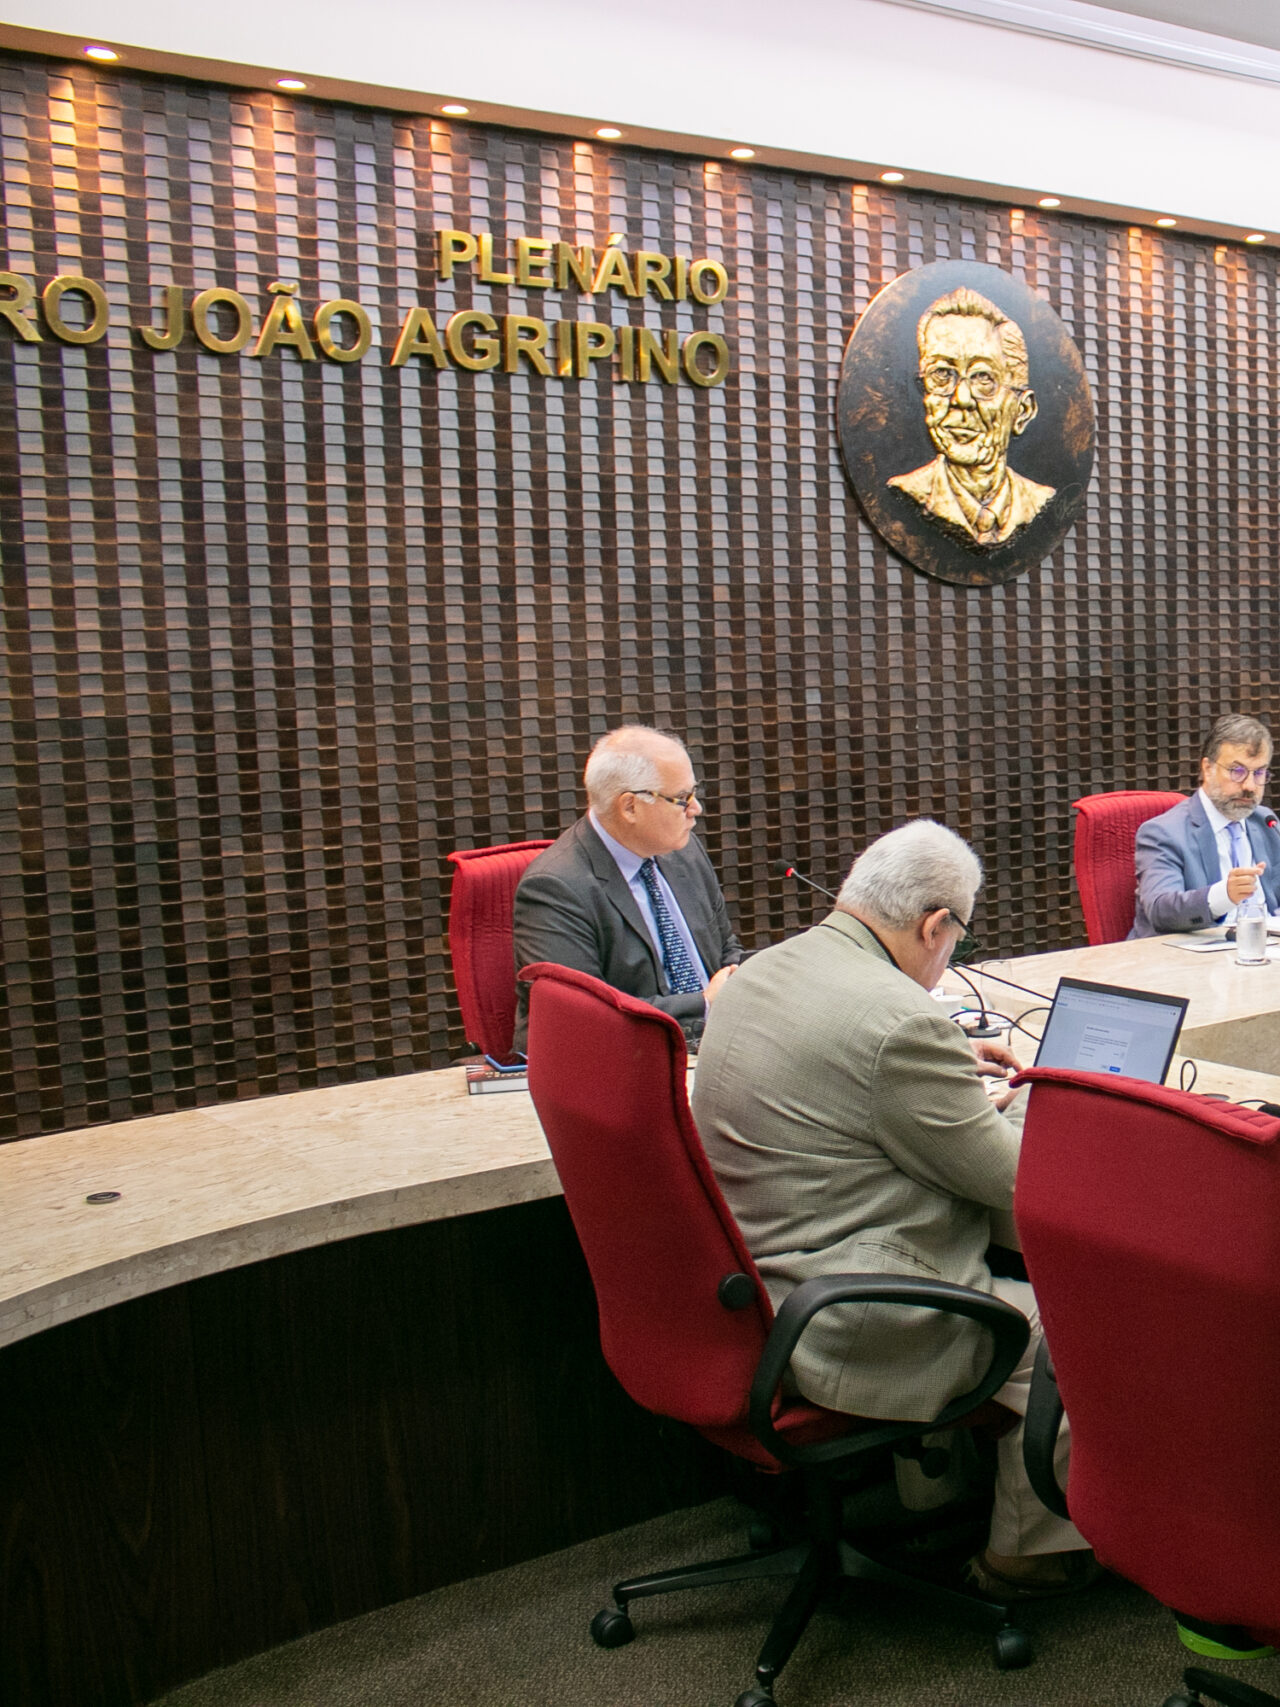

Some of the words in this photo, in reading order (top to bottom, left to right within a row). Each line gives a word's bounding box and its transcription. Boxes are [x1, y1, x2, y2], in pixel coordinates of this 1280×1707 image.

[439, 229, 729, 306] PLENÁRIO
[138, 281, 372, 363] JOÃO
[389, 306, 730, 388] AGRIPINO
